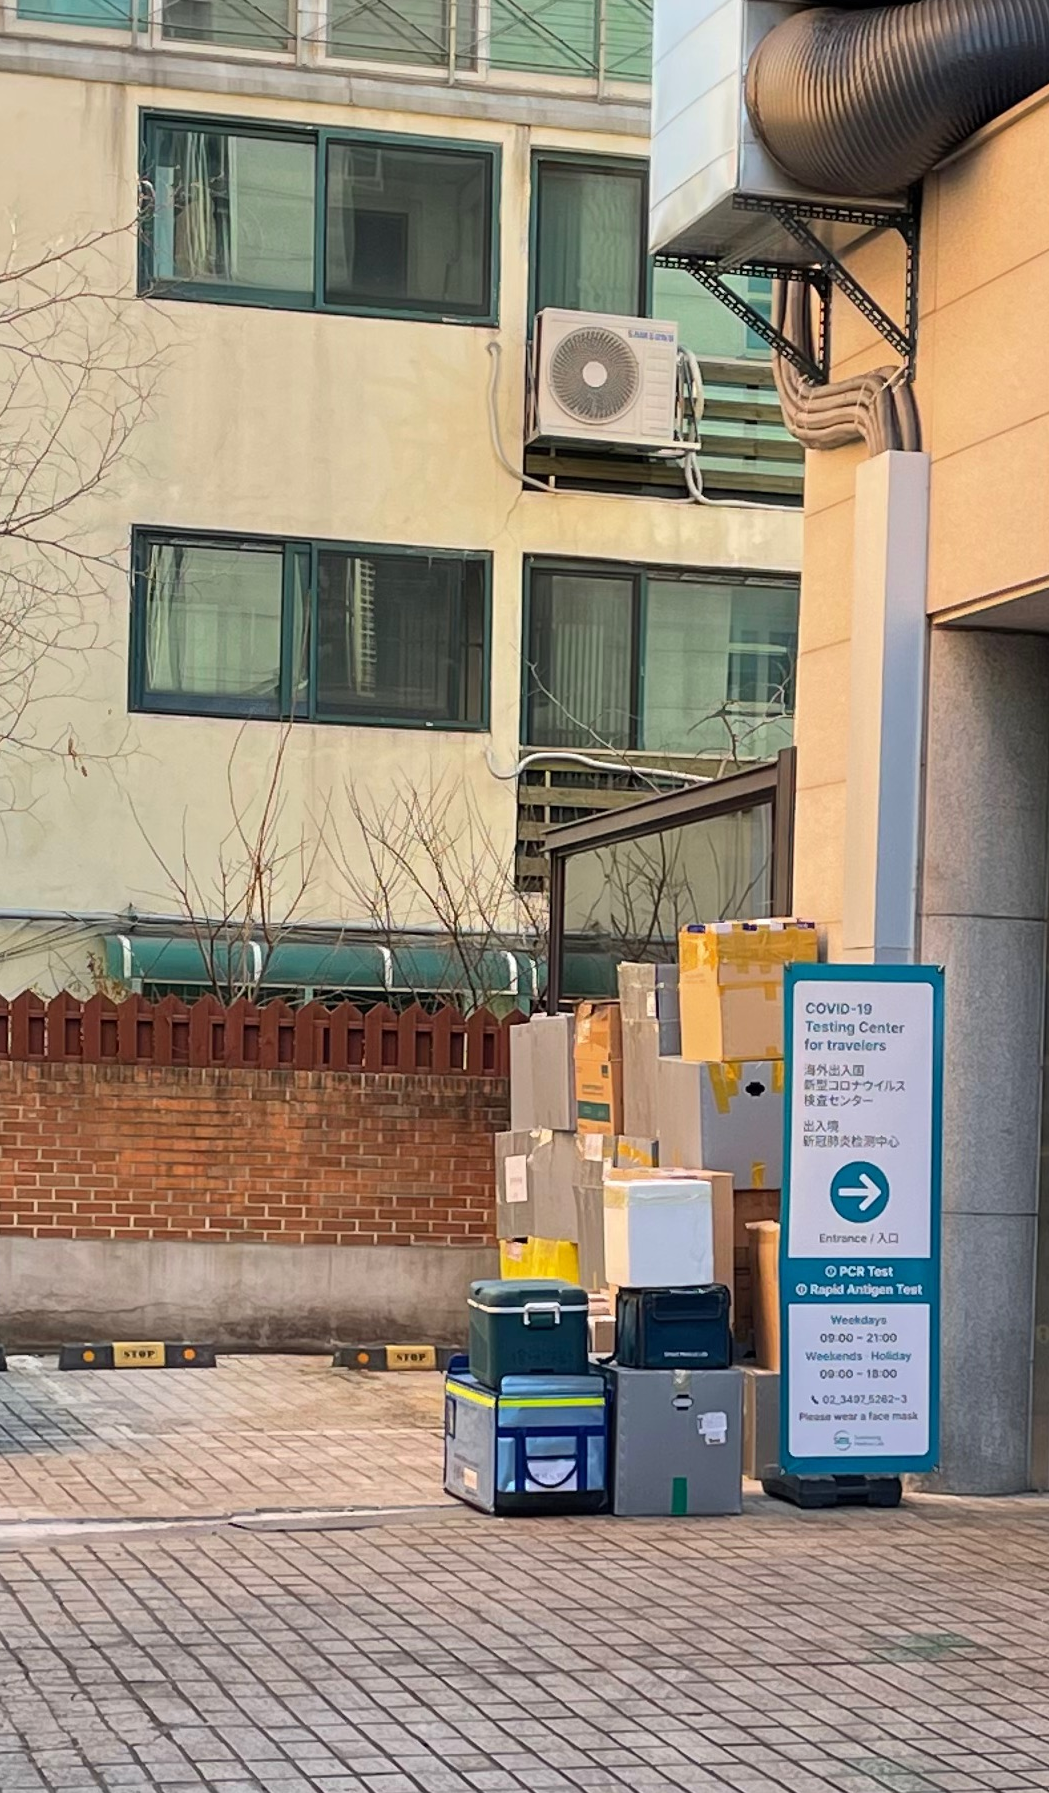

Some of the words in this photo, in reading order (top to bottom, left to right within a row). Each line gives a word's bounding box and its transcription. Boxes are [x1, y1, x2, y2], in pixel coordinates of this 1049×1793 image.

[805, 1002, 873, 1015] COVID-19
[804, 1020, 855, 1036] Testing
[858, 1021, 905, 1034] Center
[804, 1038, 824, 1051] for
[827, 1039, 887, 1051] travelers
[803, 1079, 906, 1092] 新型コロナウイルス
[803, 1094, 874, 1107] 検査センター
[819, 1233, 868, 1244] Entrance
[876, 1232, 899, 1245] 入口
[839, 1265, 865, 1278] PCR
[867, 1265, 894, 1278] Test
[809, 1283, 845, 1298] Rapid
[846, 1283, 894, 1298] Antigen
[896, 1283, 923, 1295] Test
[830, 1315, 888, 1326] Weekdays
[866, 1333, 898, 1343] 21:00
[122, 1349, 156, 1360] STOP
[396, 1352, 427, 1362] STOP
[805, 1351, 863, 1361] Weekends
[871, 1351, 912, 1363] Holiday
[866, 1369, 898, 1379] 18:00
[798, 1411, 832, 1422] Please
[833, 1412, 858, 1421] wear
[860, 1412, 867, 1421] a
[868, 1411, 890, 1421] face
[892, 1411, 918, 1421] mask
